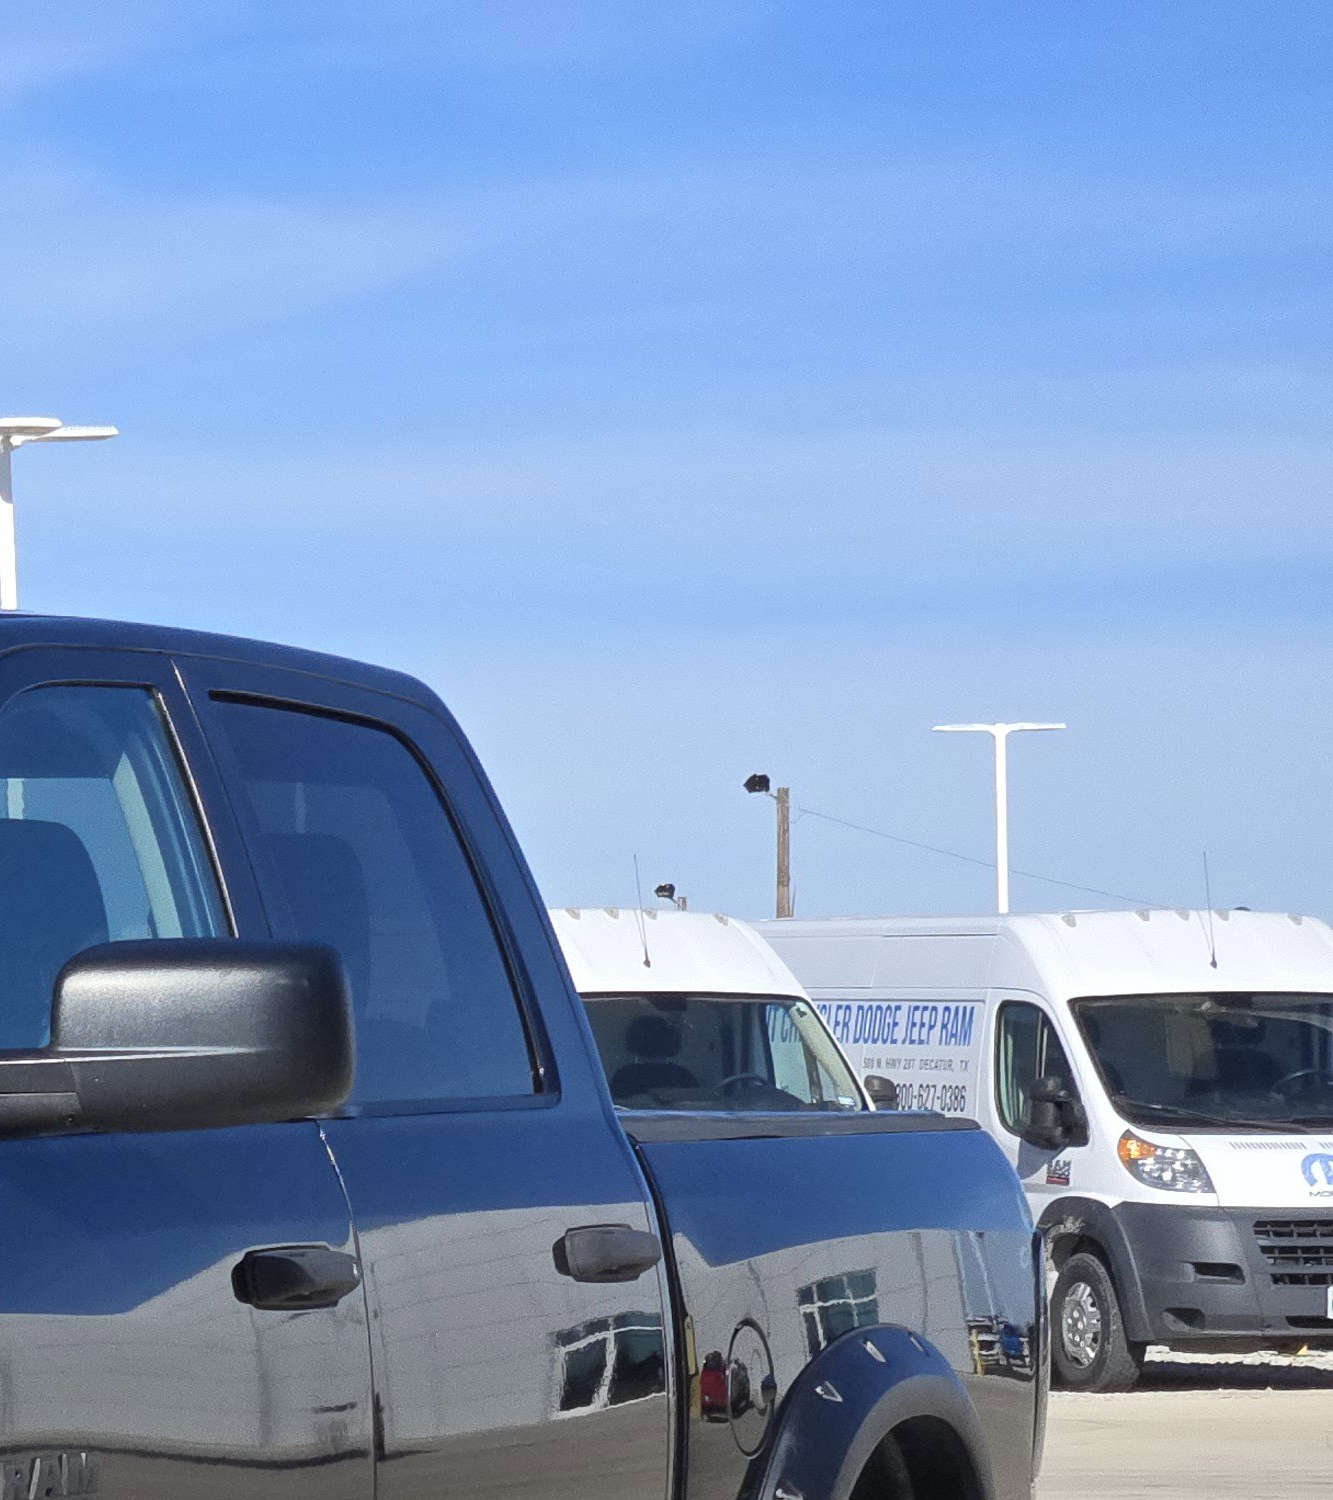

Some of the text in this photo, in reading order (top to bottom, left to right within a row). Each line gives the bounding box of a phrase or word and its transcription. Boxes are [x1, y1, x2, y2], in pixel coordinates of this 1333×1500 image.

[853, 1004, 901, 1044] DODGE
[902, 1004, 937, 1045] JEEP
[939, 1005, 975, 1047] RAM
[960, 1060, 969, 1071] TX
